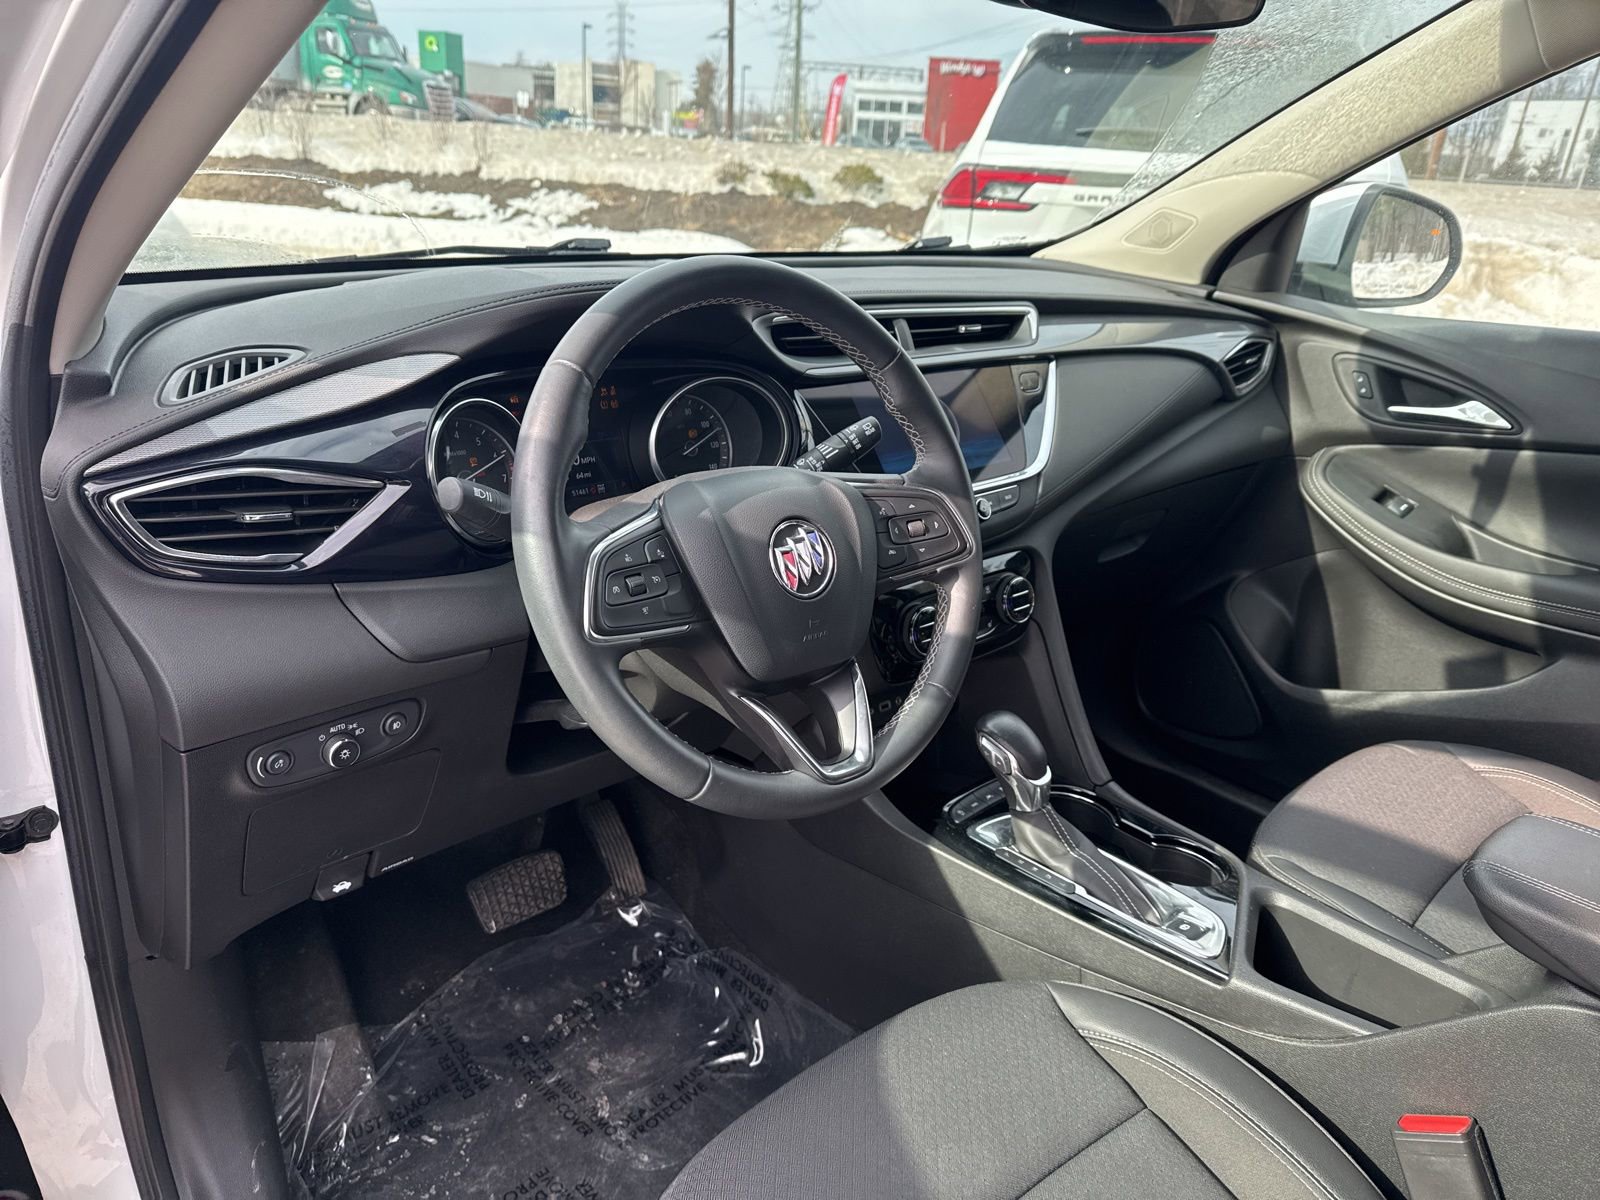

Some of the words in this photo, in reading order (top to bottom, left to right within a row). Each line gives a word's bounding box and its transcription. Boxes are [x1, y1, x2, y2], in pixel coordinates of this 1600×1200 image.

[700, 420, 711, 430] 100
[453, 430, 460, 439] 4
[475, 436, 482, 447] 5
[709, 440, 720, 449] 120
[580, 456, 596, 465] MPH
[501, 473, 508, 484] 7
[329, 722, 346, 734] AUTO
[436, 1016, 491, 1092] PROTECTIVE
[437, 1053, 476, 1100] DEALER
[554, 1077, 587, 1105] MUST
[350, 1115, 384, 1139] UST
[387, 1083, 451, 1124] REMOVE
[628, 1081, 709, 1141] PROTECTIVE
[556, 1103, 594, 1138] COVER
